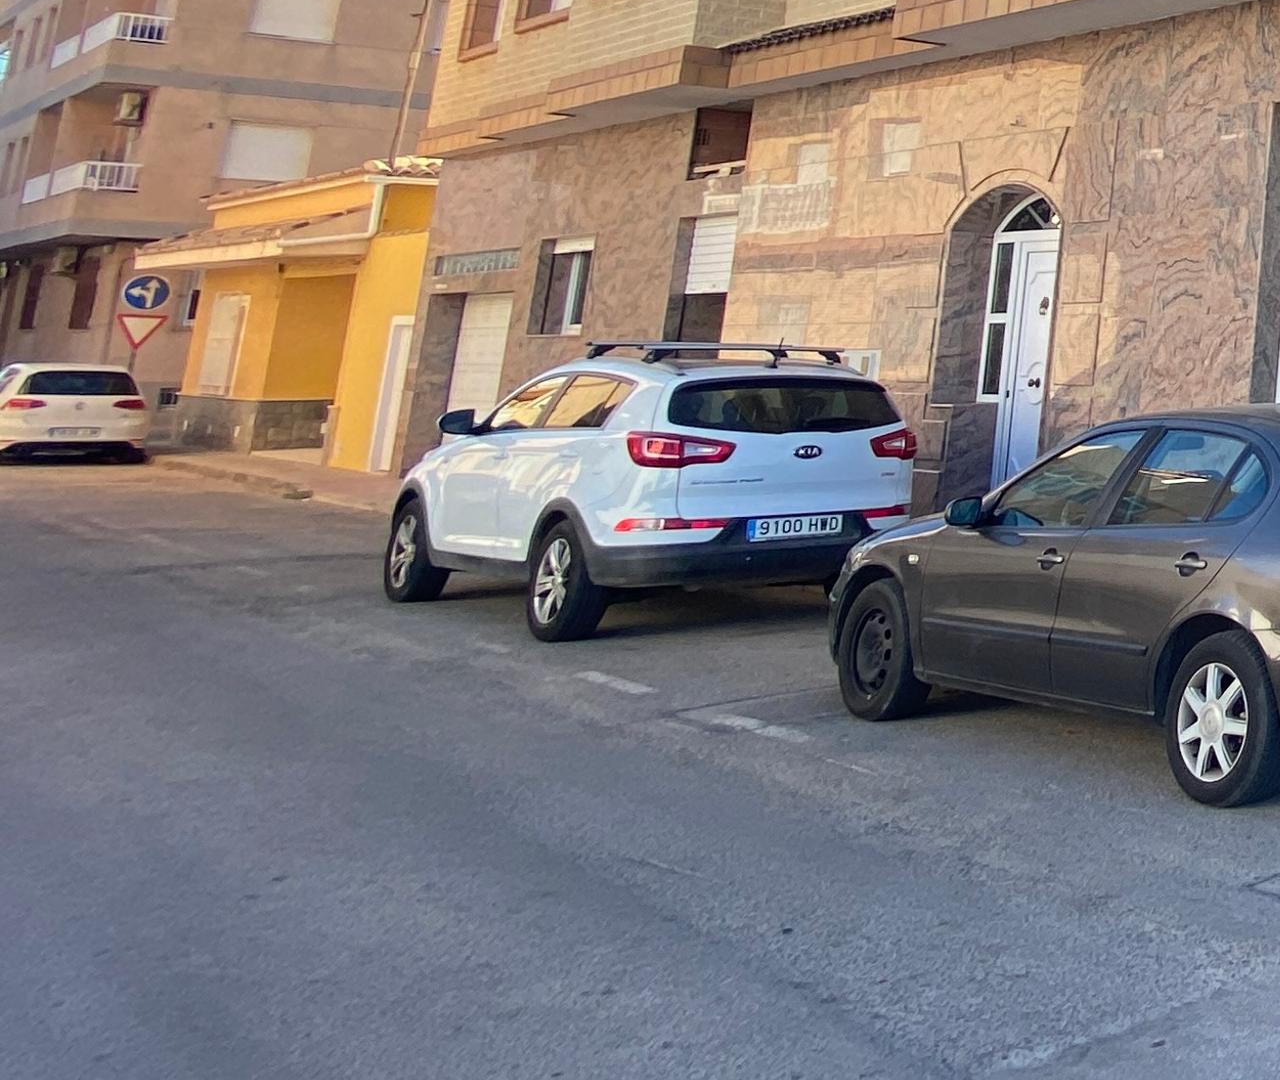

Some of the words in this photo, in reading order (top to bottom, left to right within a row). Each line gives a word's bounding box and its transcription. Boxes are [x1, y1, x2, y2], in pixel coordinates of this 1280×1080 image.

[798, 447, 820, 457] KIA
[760, 519, 803, 535] 9100
[809, 516, 839, 532] HWD
